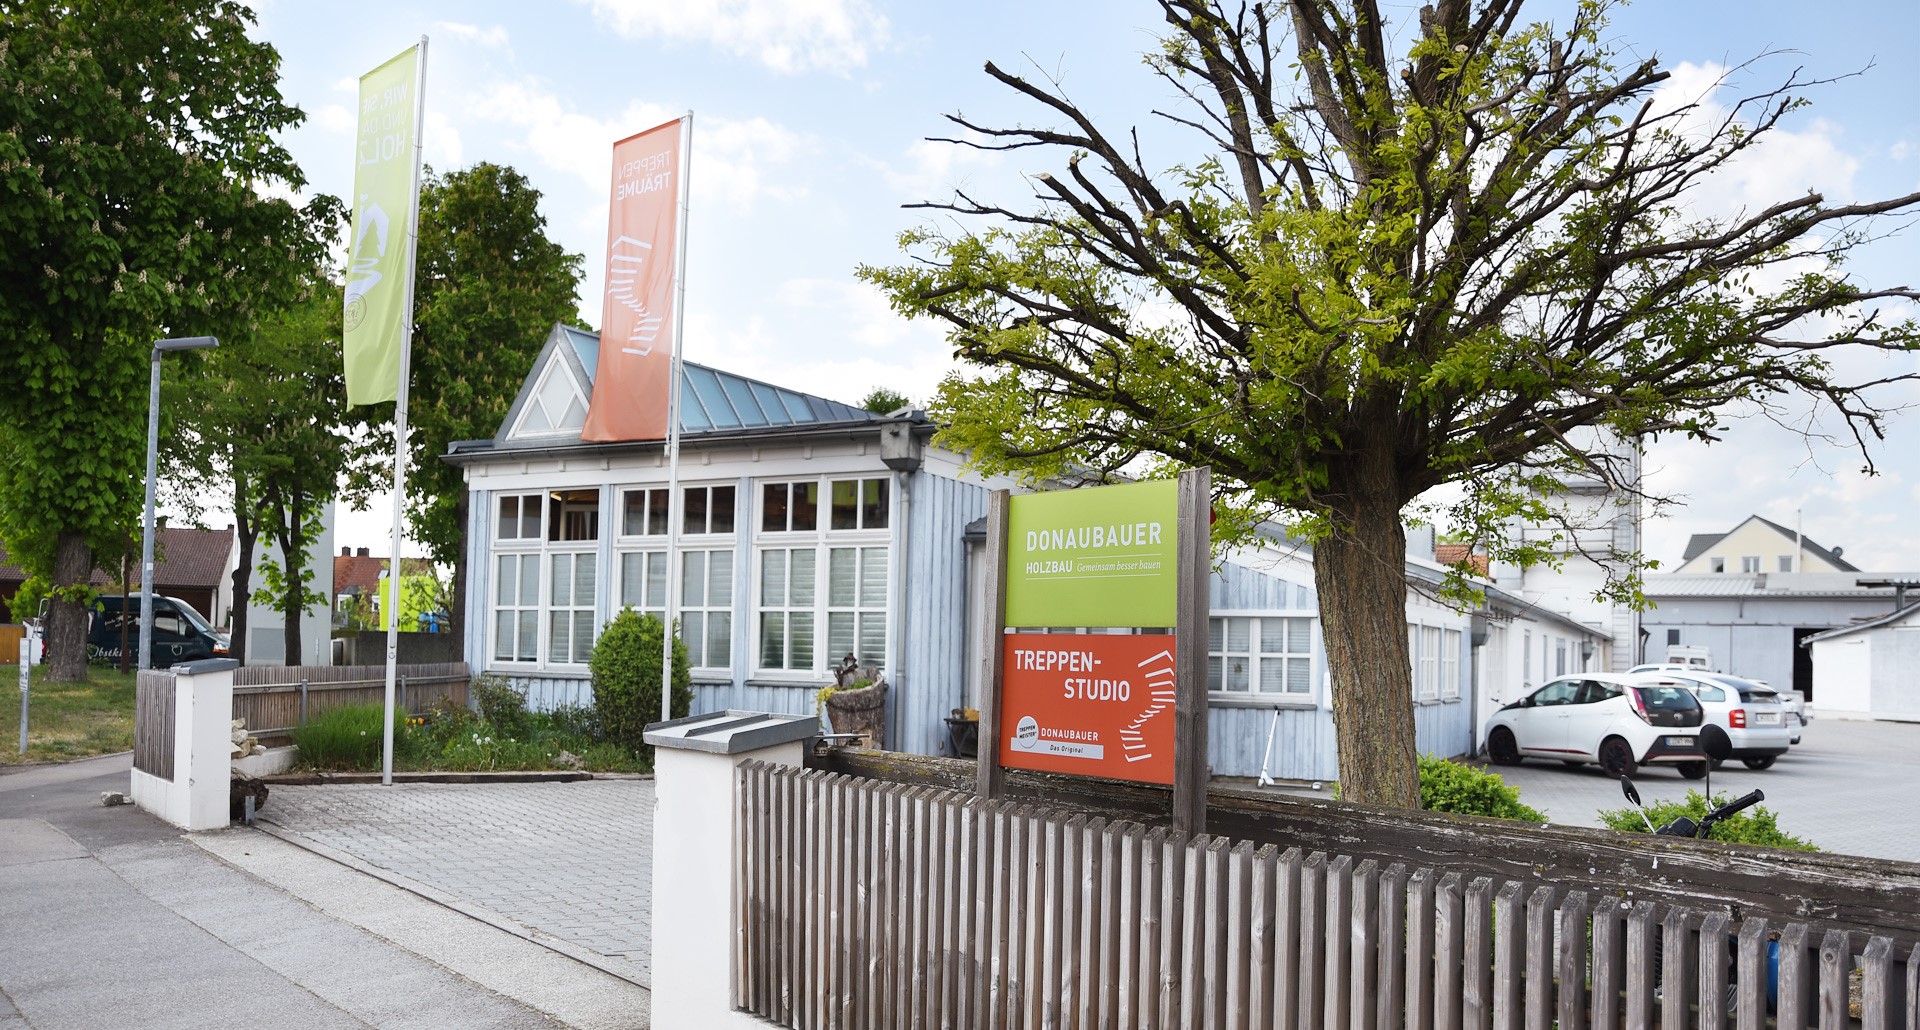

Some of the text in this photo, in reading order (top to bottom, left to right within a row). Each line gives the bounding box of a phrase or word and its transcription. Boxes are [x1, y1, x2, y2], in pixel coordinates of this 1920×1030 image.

[1026, 522, 1162, 552] DONAUBAUER
[1026, 560, 1161, 574] HOLZBAU Gemeinsam besser bauen
[1014, 650, 1102, 672] TREPPEN-
[1064, 678, 1131, 702] STUDIO
[1041, 728, 1099, 741] DONAUBAUER
[1049, 744, 1084, 754] Das Original
